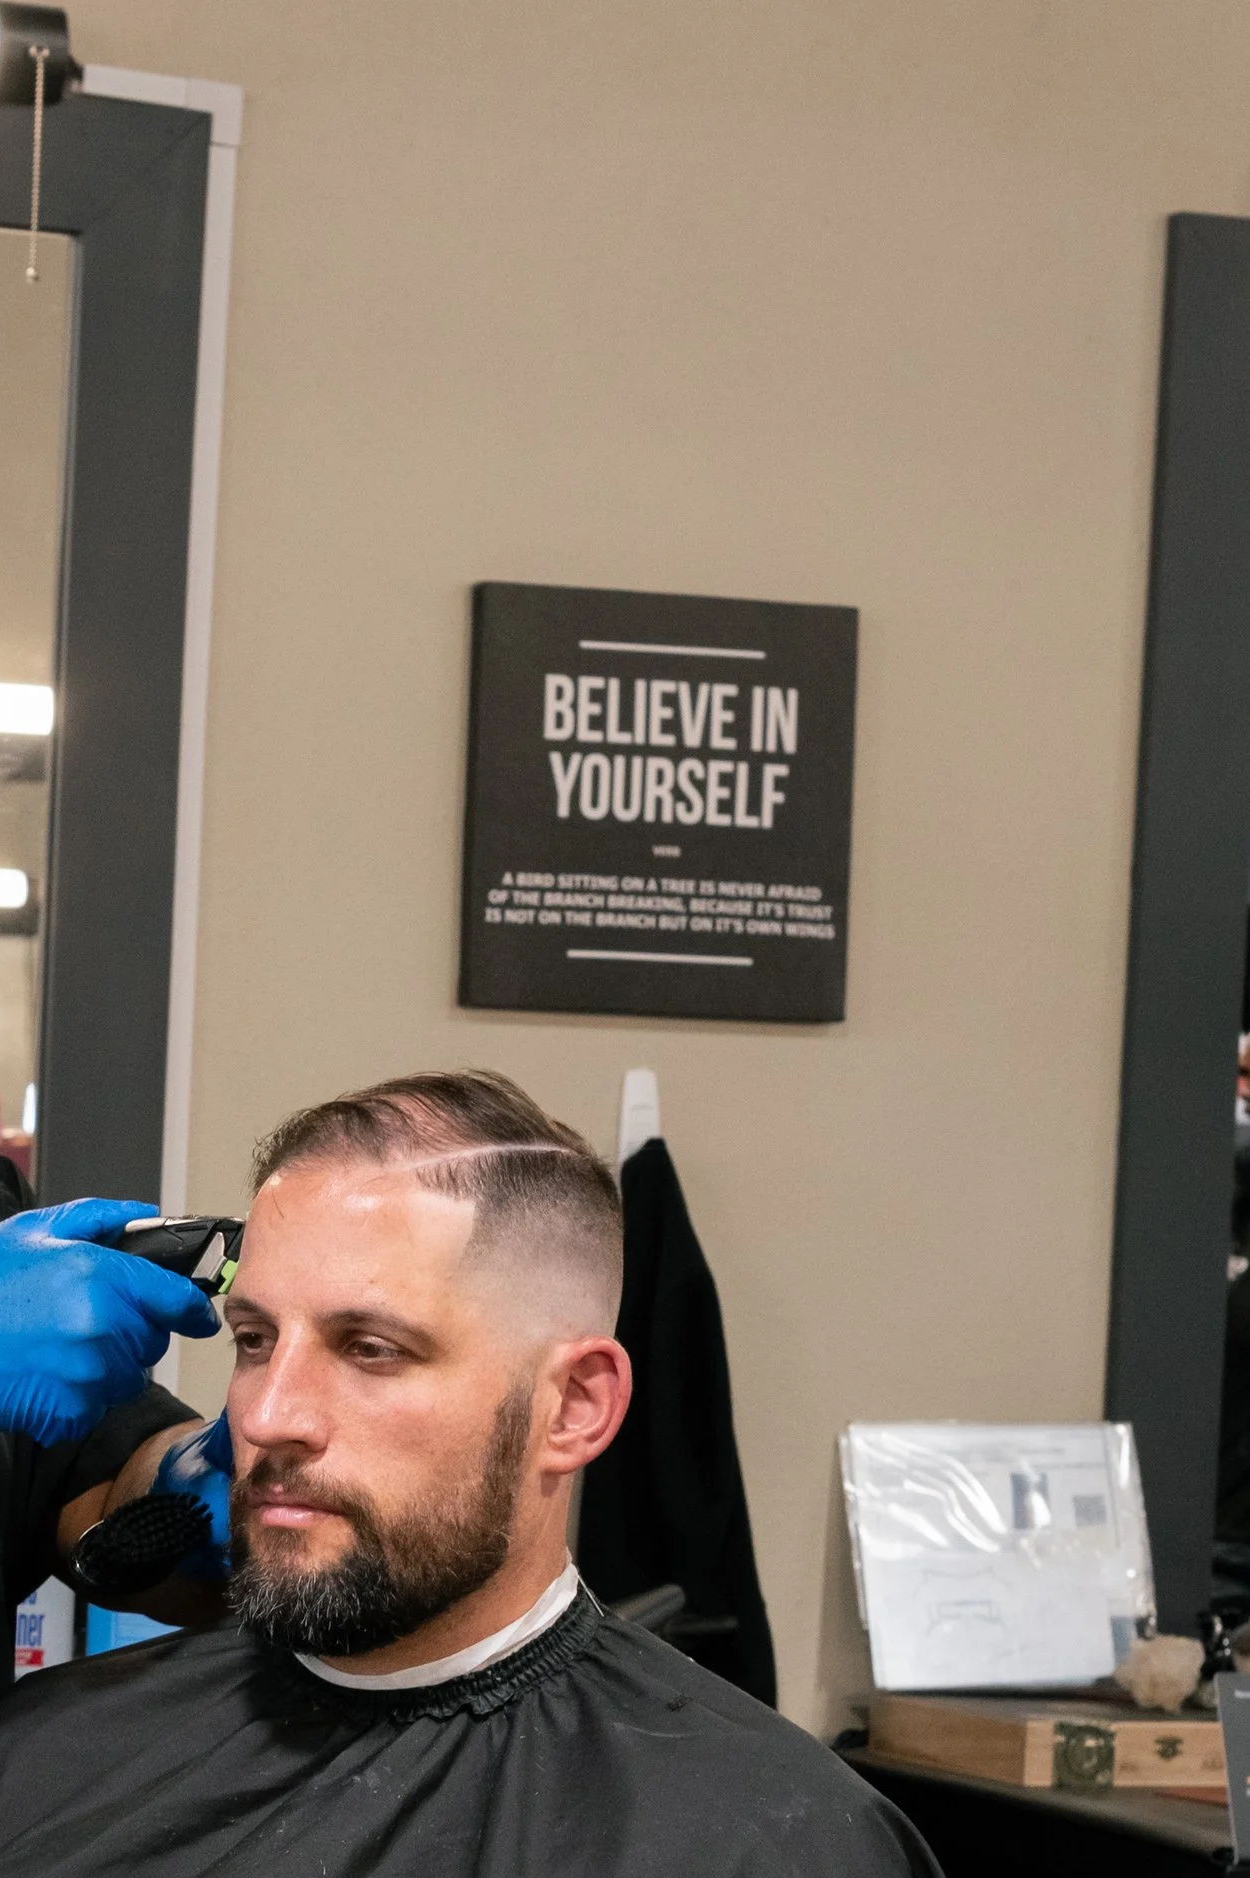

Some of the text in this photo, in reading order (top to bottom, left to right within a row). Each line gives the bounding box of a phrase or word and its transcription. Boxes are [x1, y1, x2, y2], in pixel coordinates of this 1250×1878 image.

[543, 673, 799, 754] BELIEVE IN
[549, 751, 790, 830] YOURSELF
[502, 871, 823, 902] A BIRD SITTING ON A TREE IS NEVER AFRAID
[487, 888, 510, 904] OF
[512, 890, 540, 906] THE
[543, 891, 605, 908] BRANCH
[688, 898, 753, 916] BECAUSE
[787, 903, 833, 921] TRUST
[484, 907, 502, 923] IS
[504, 908, 536, 924] NOT
[537, 909, 562, 925] ON
[564, 911, 593, 927] THE
[595, 912, 657, 929] BRANCH
[658, 914, 688, 931] BUT
[689, 916, 714, 932] ON
[745, 919, 782, 935] OWN
[784, 921, 836, 939] WINGS
